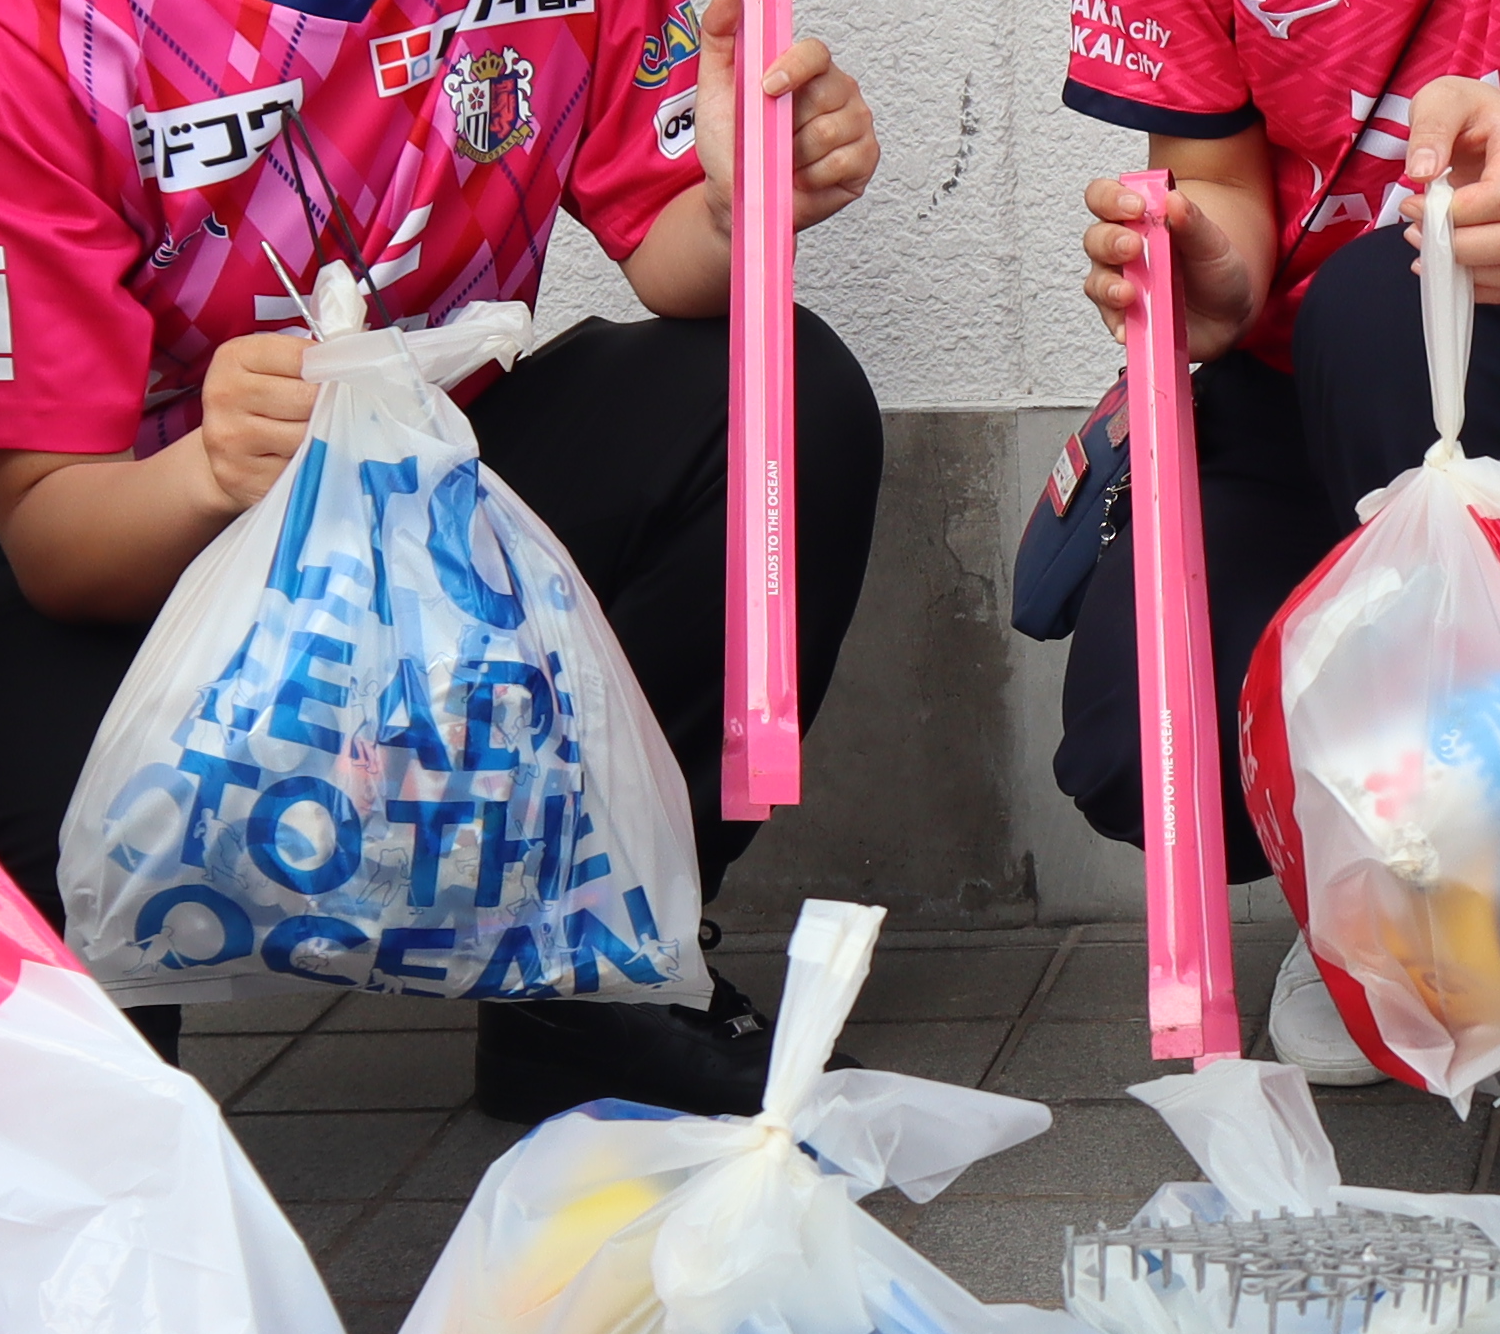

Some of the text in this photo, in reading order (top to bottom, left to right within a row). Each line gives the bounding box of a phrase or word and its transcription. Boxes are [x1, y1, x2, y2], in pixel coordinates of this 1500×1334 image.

[1071, 26, 1164, 81] KAI city
[1129, 19, 1172, 48] city
[767, 460, 779, 596] LEADS TO THE OCEAN
[1160, 709, 1176, 846] LEADS TO THE OCEAN
